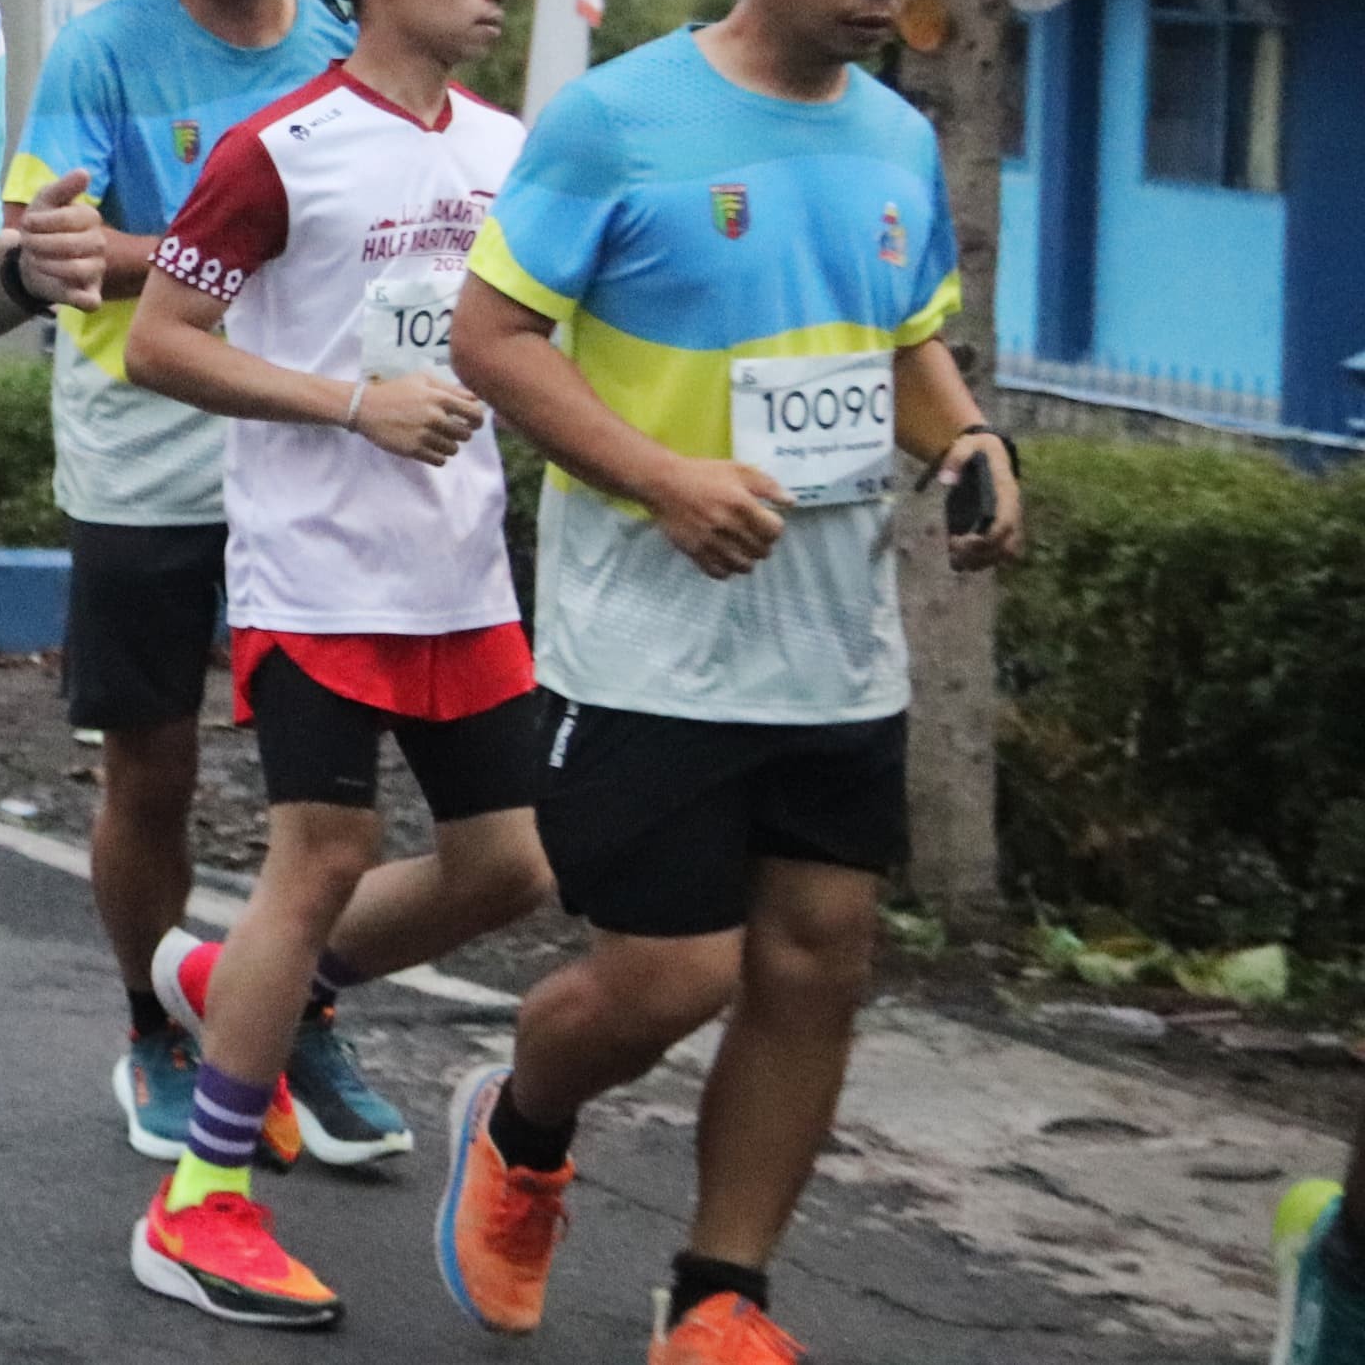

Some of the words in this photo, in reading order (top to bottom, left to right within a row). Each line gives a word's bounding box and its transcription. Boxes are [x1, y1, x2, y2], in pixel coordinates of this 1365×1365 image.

[362, 232, 408, 262] HALF
[433, 257, 465, 272] 202
[394, 309, 454, 348] 102
